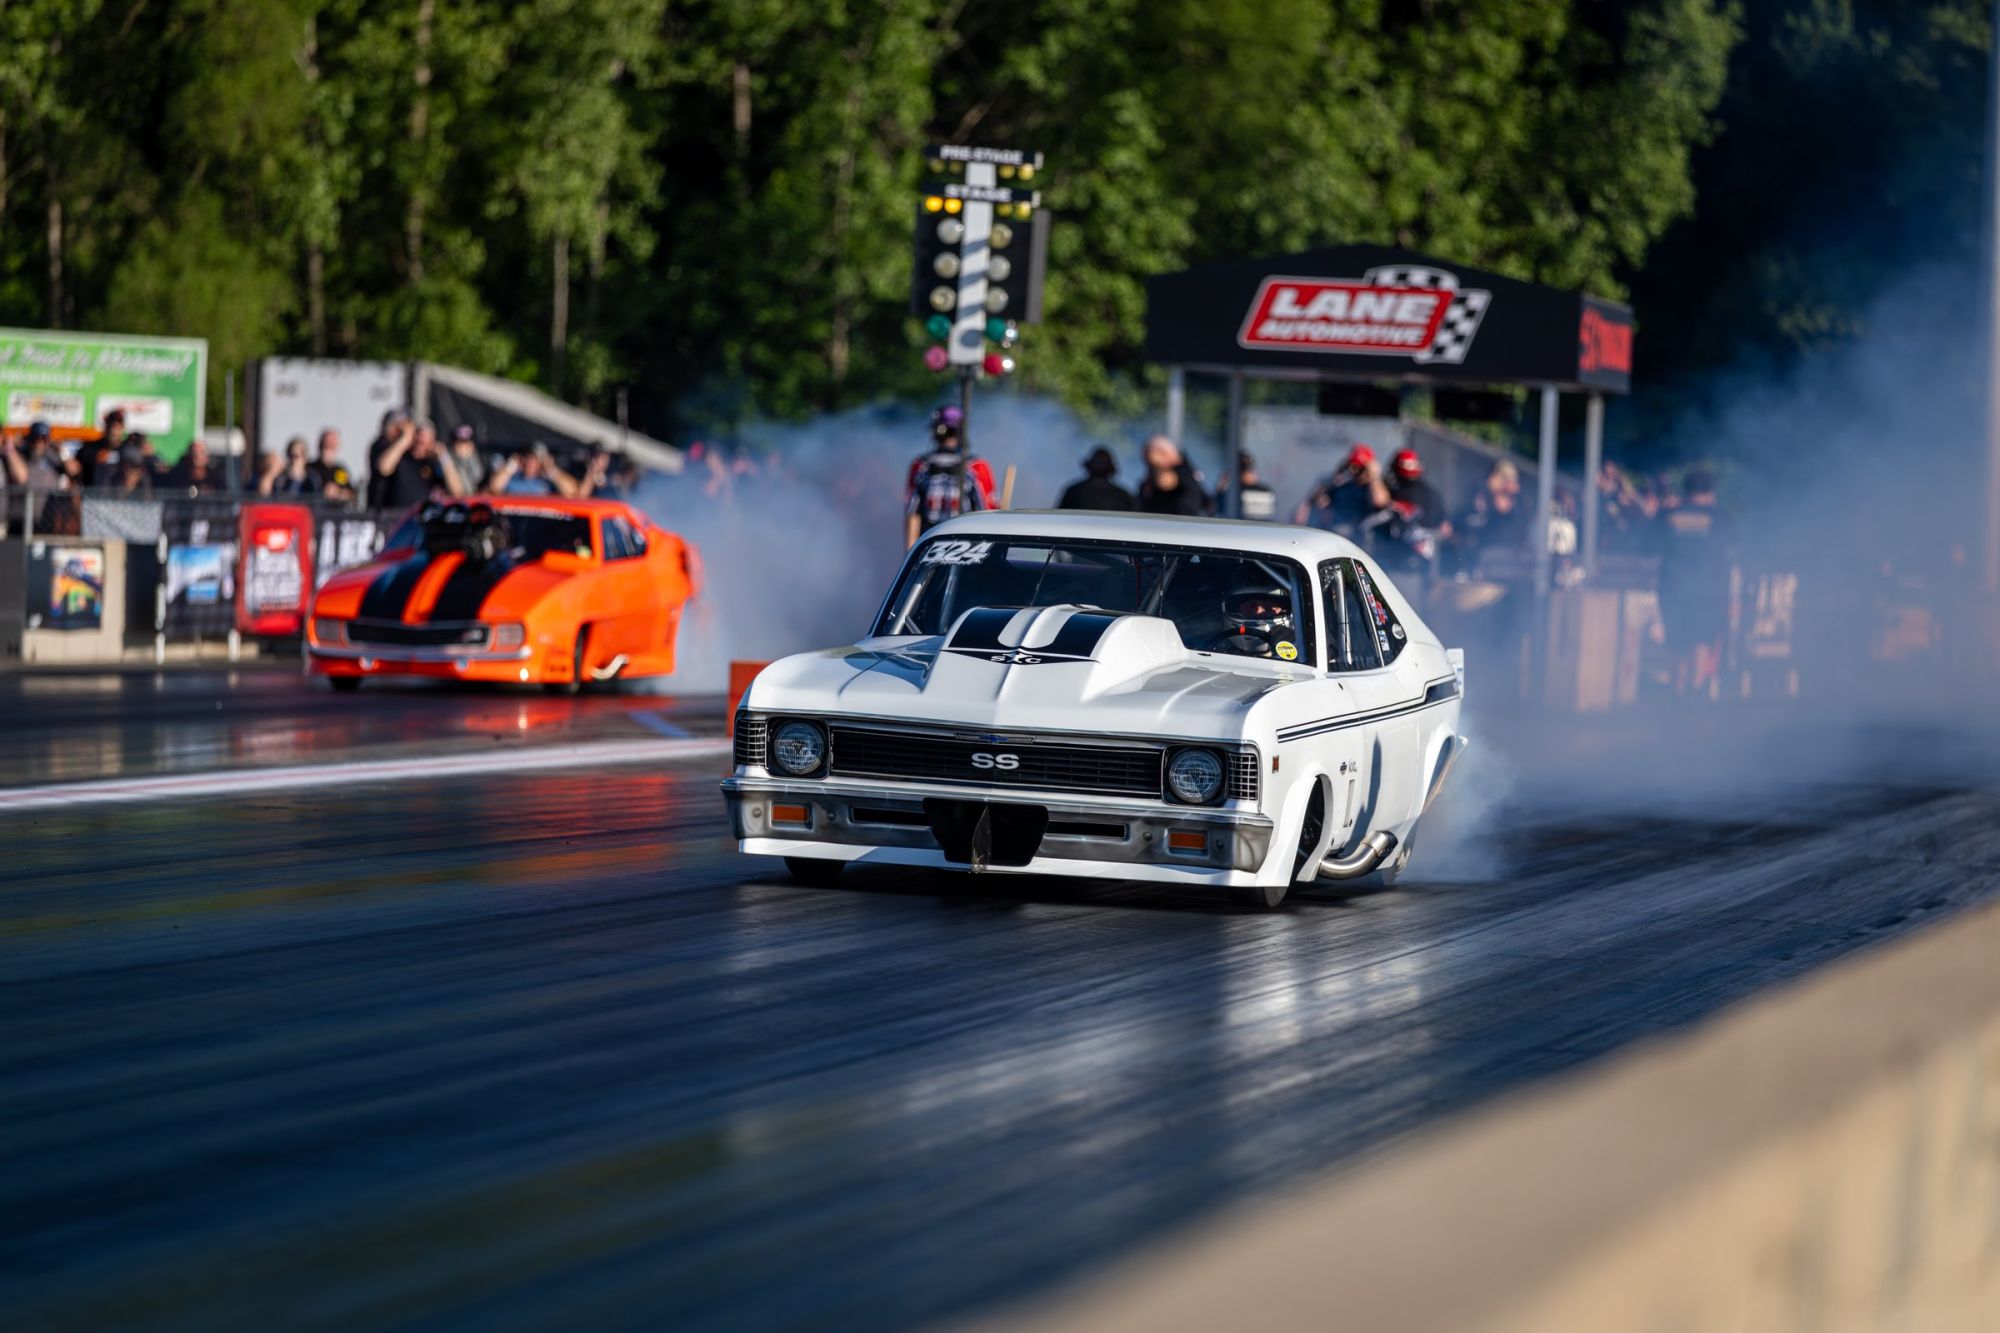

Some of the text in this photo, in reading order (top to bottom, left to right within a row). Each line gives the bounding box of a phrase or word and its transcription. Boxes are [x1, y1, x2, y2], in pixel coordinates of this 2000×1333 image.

[945, 183, 1012, 202] STAGE
[1268, 287, 1441, 325] LANE
[1256, 319, 1427, 346] AUTOMOTIVE
[920, 541, 993, 565] 324
[971, 752, 1020, 769] SS
